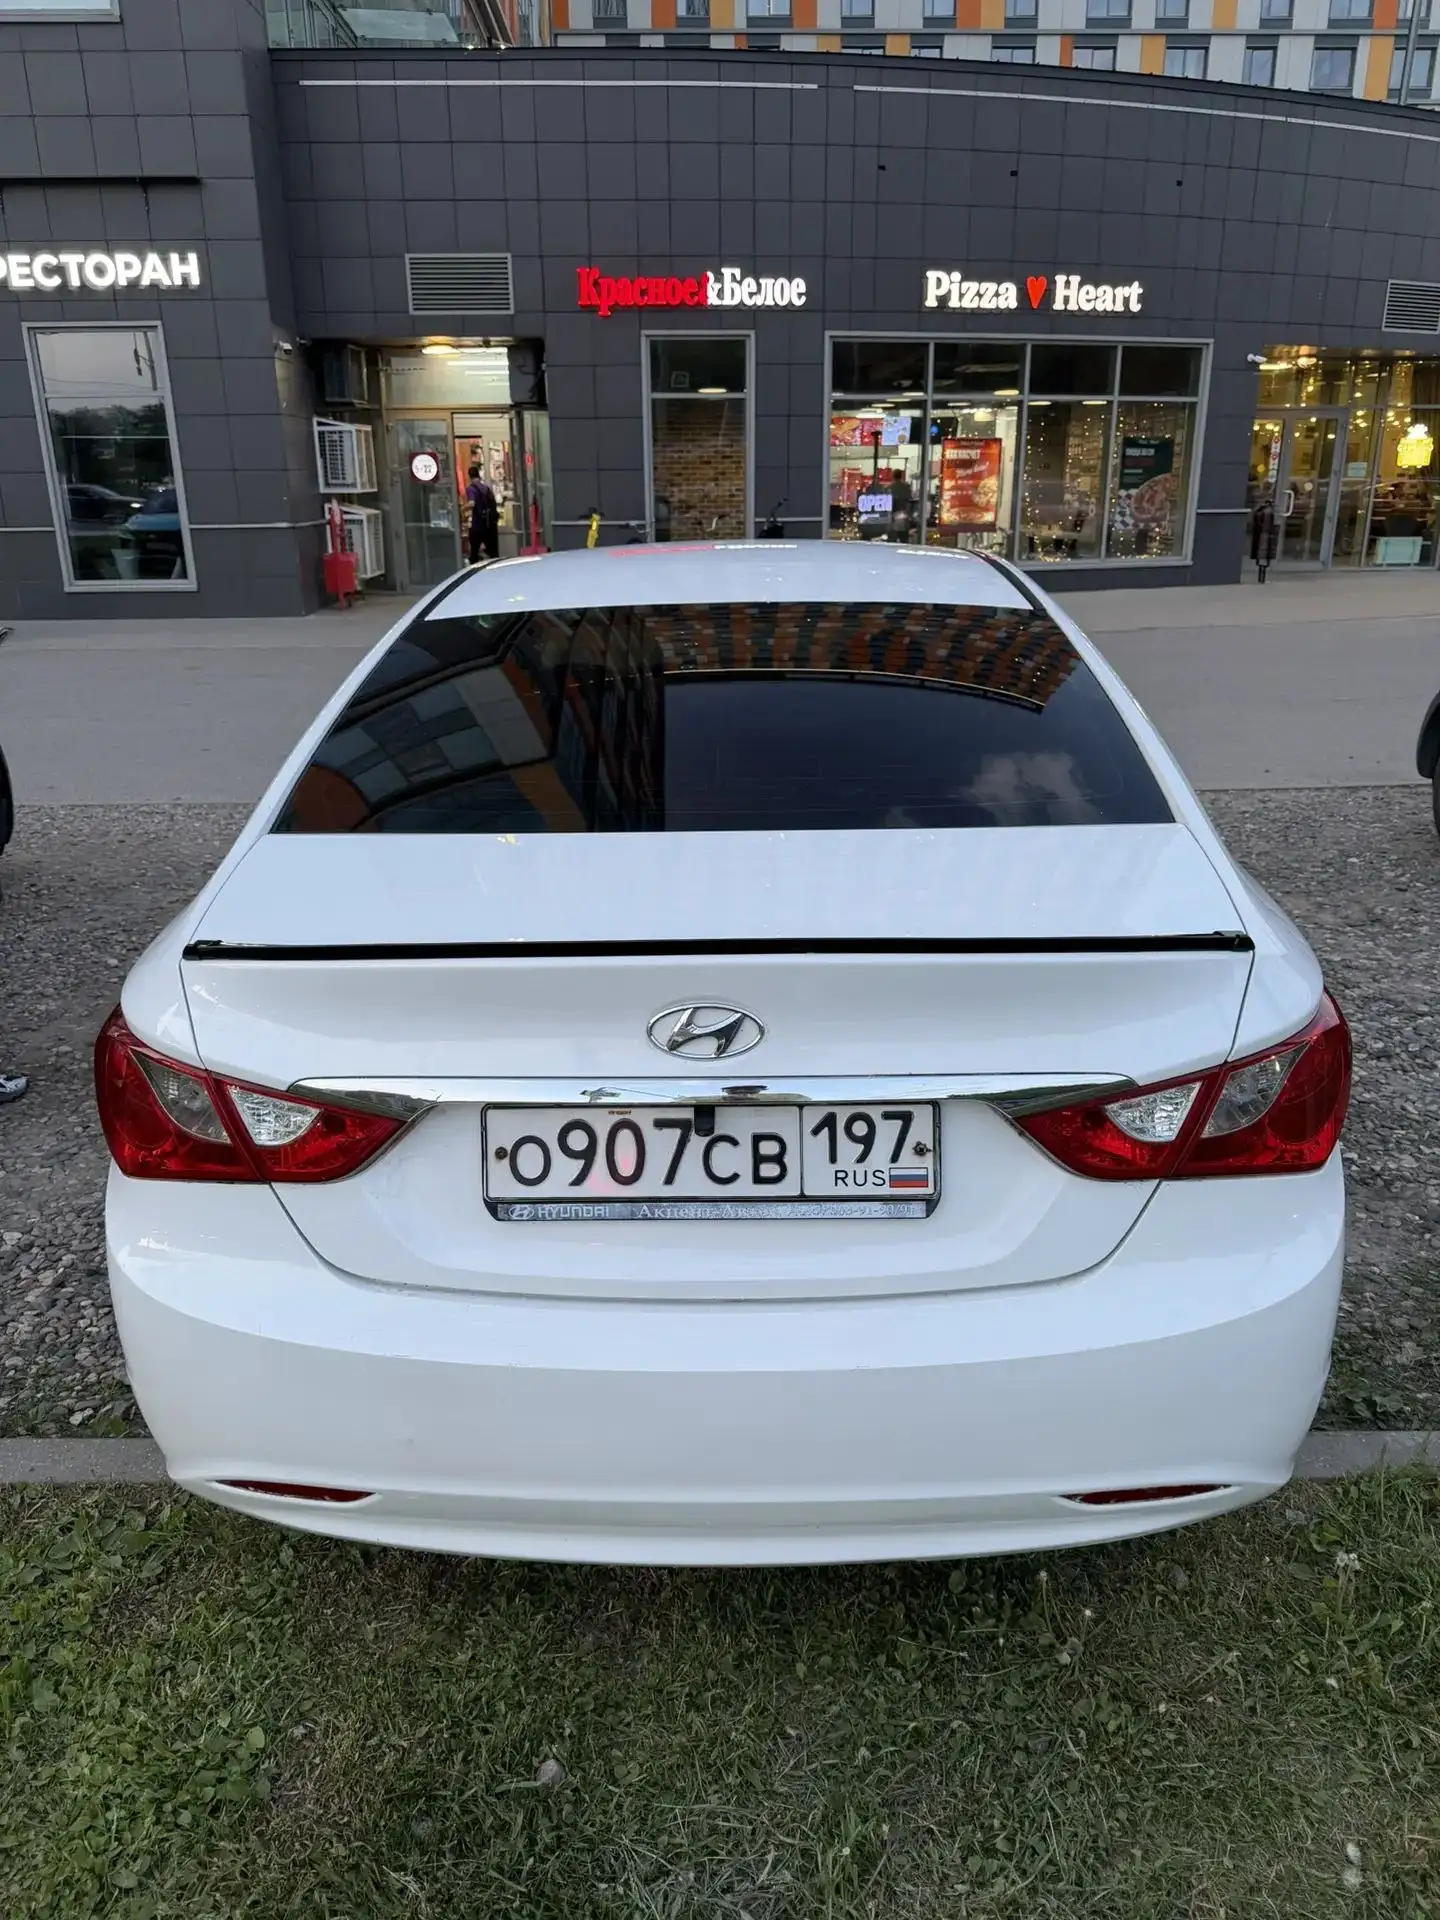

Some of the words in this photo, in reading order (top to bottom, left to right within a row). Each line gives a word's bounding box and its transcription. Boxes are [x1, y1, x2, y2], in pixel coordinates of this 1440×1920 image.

[924, 270, 1018, 309] Pizza
[1052, 274, 1144, 312] Heart
[858, 494, 893, 512] OPEN
[810, 1111, 916, 1165] 197
[834, 1169, 886, 1187] RUS
[538, 1205, 609, 1218] HYUNDAI
